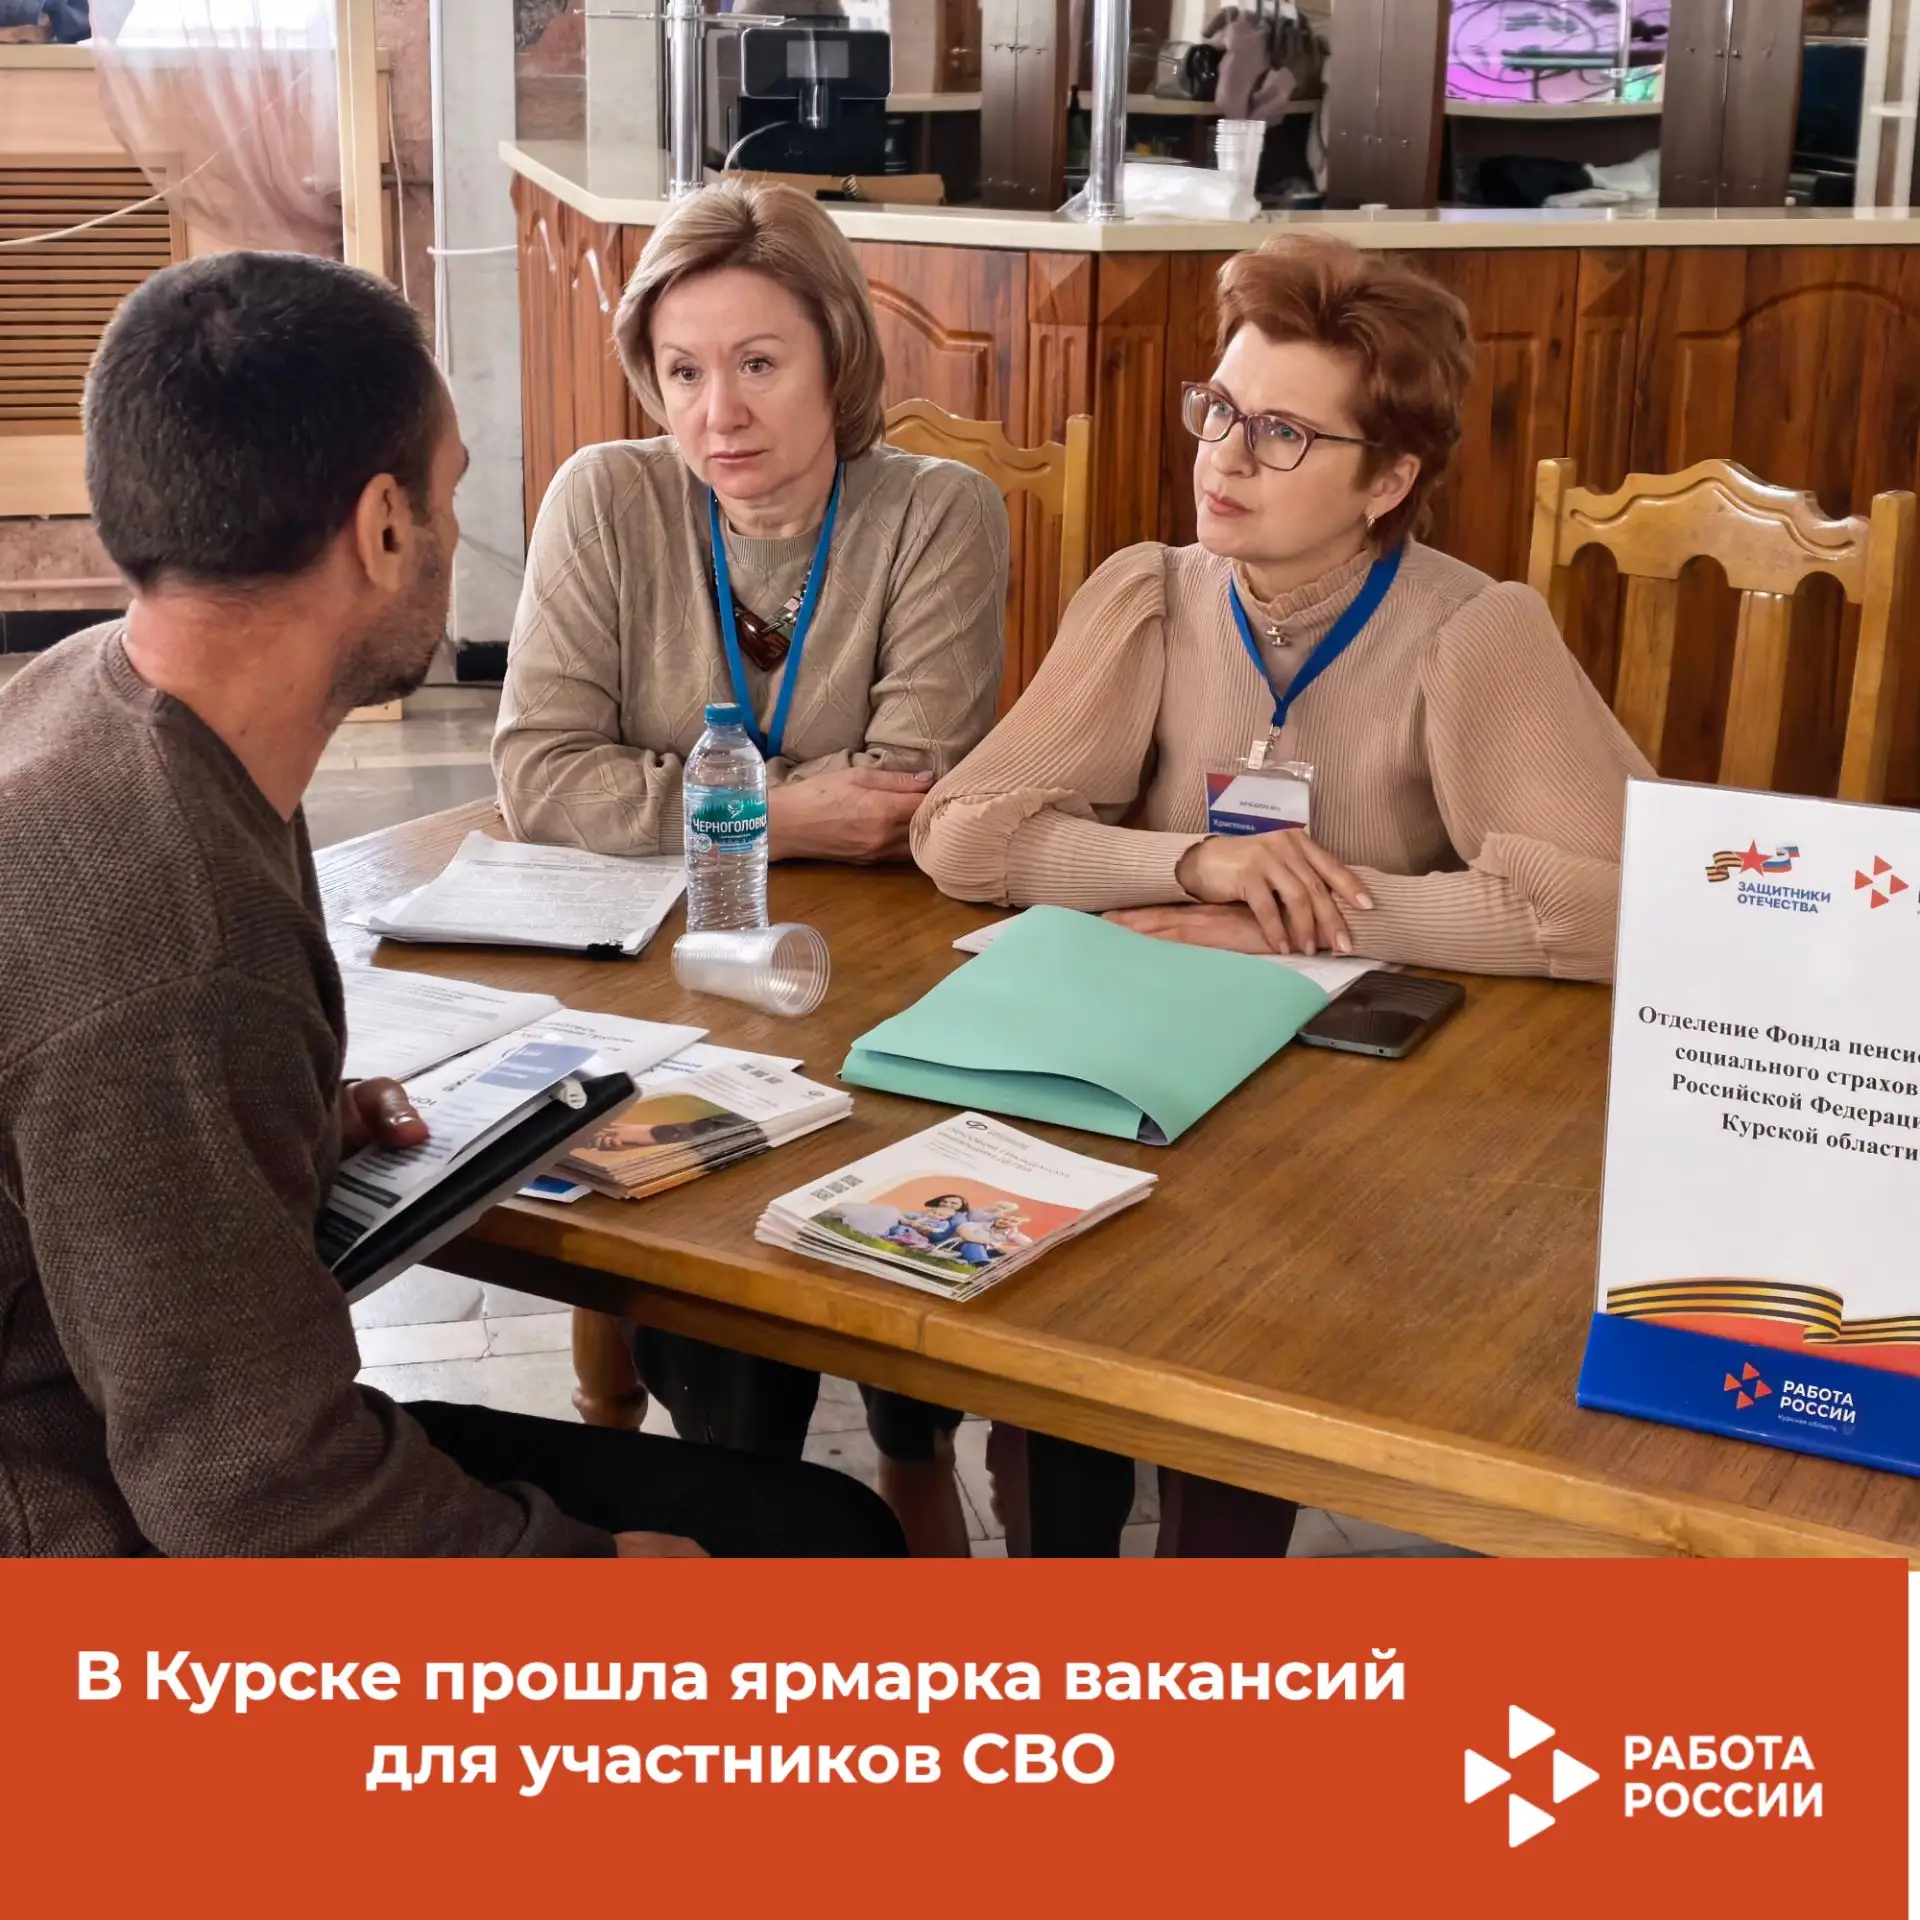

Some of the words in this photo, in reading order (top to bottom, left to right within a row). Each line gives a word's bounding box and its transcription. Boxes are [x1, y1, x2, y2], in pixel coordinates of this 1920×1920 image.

[1737, 881, 1831, 903] ЗАЩИТНИКИ
[1737, 894, 1819, 913] ОТЕЧЕСТВА
[1638, 1005, 1760, 1040] Отделение
[1766, 1025, 1841, 1052] Фонда
[1849, 1040, 1920, 1064] пенси
[1675, 1046, 1820, 1081] социального
[1827, 1070, 1918, 1096] страхов
[1672, 1073, 1803, 1111] Российской
[1722, 1113, 1818, 1145] Курской
[1826, 1133, 1918, 1161] области
[1780, 1396, 1856, 1424] РОССИИ
[1783, 1380, 1854, 1407] РАБОТА
